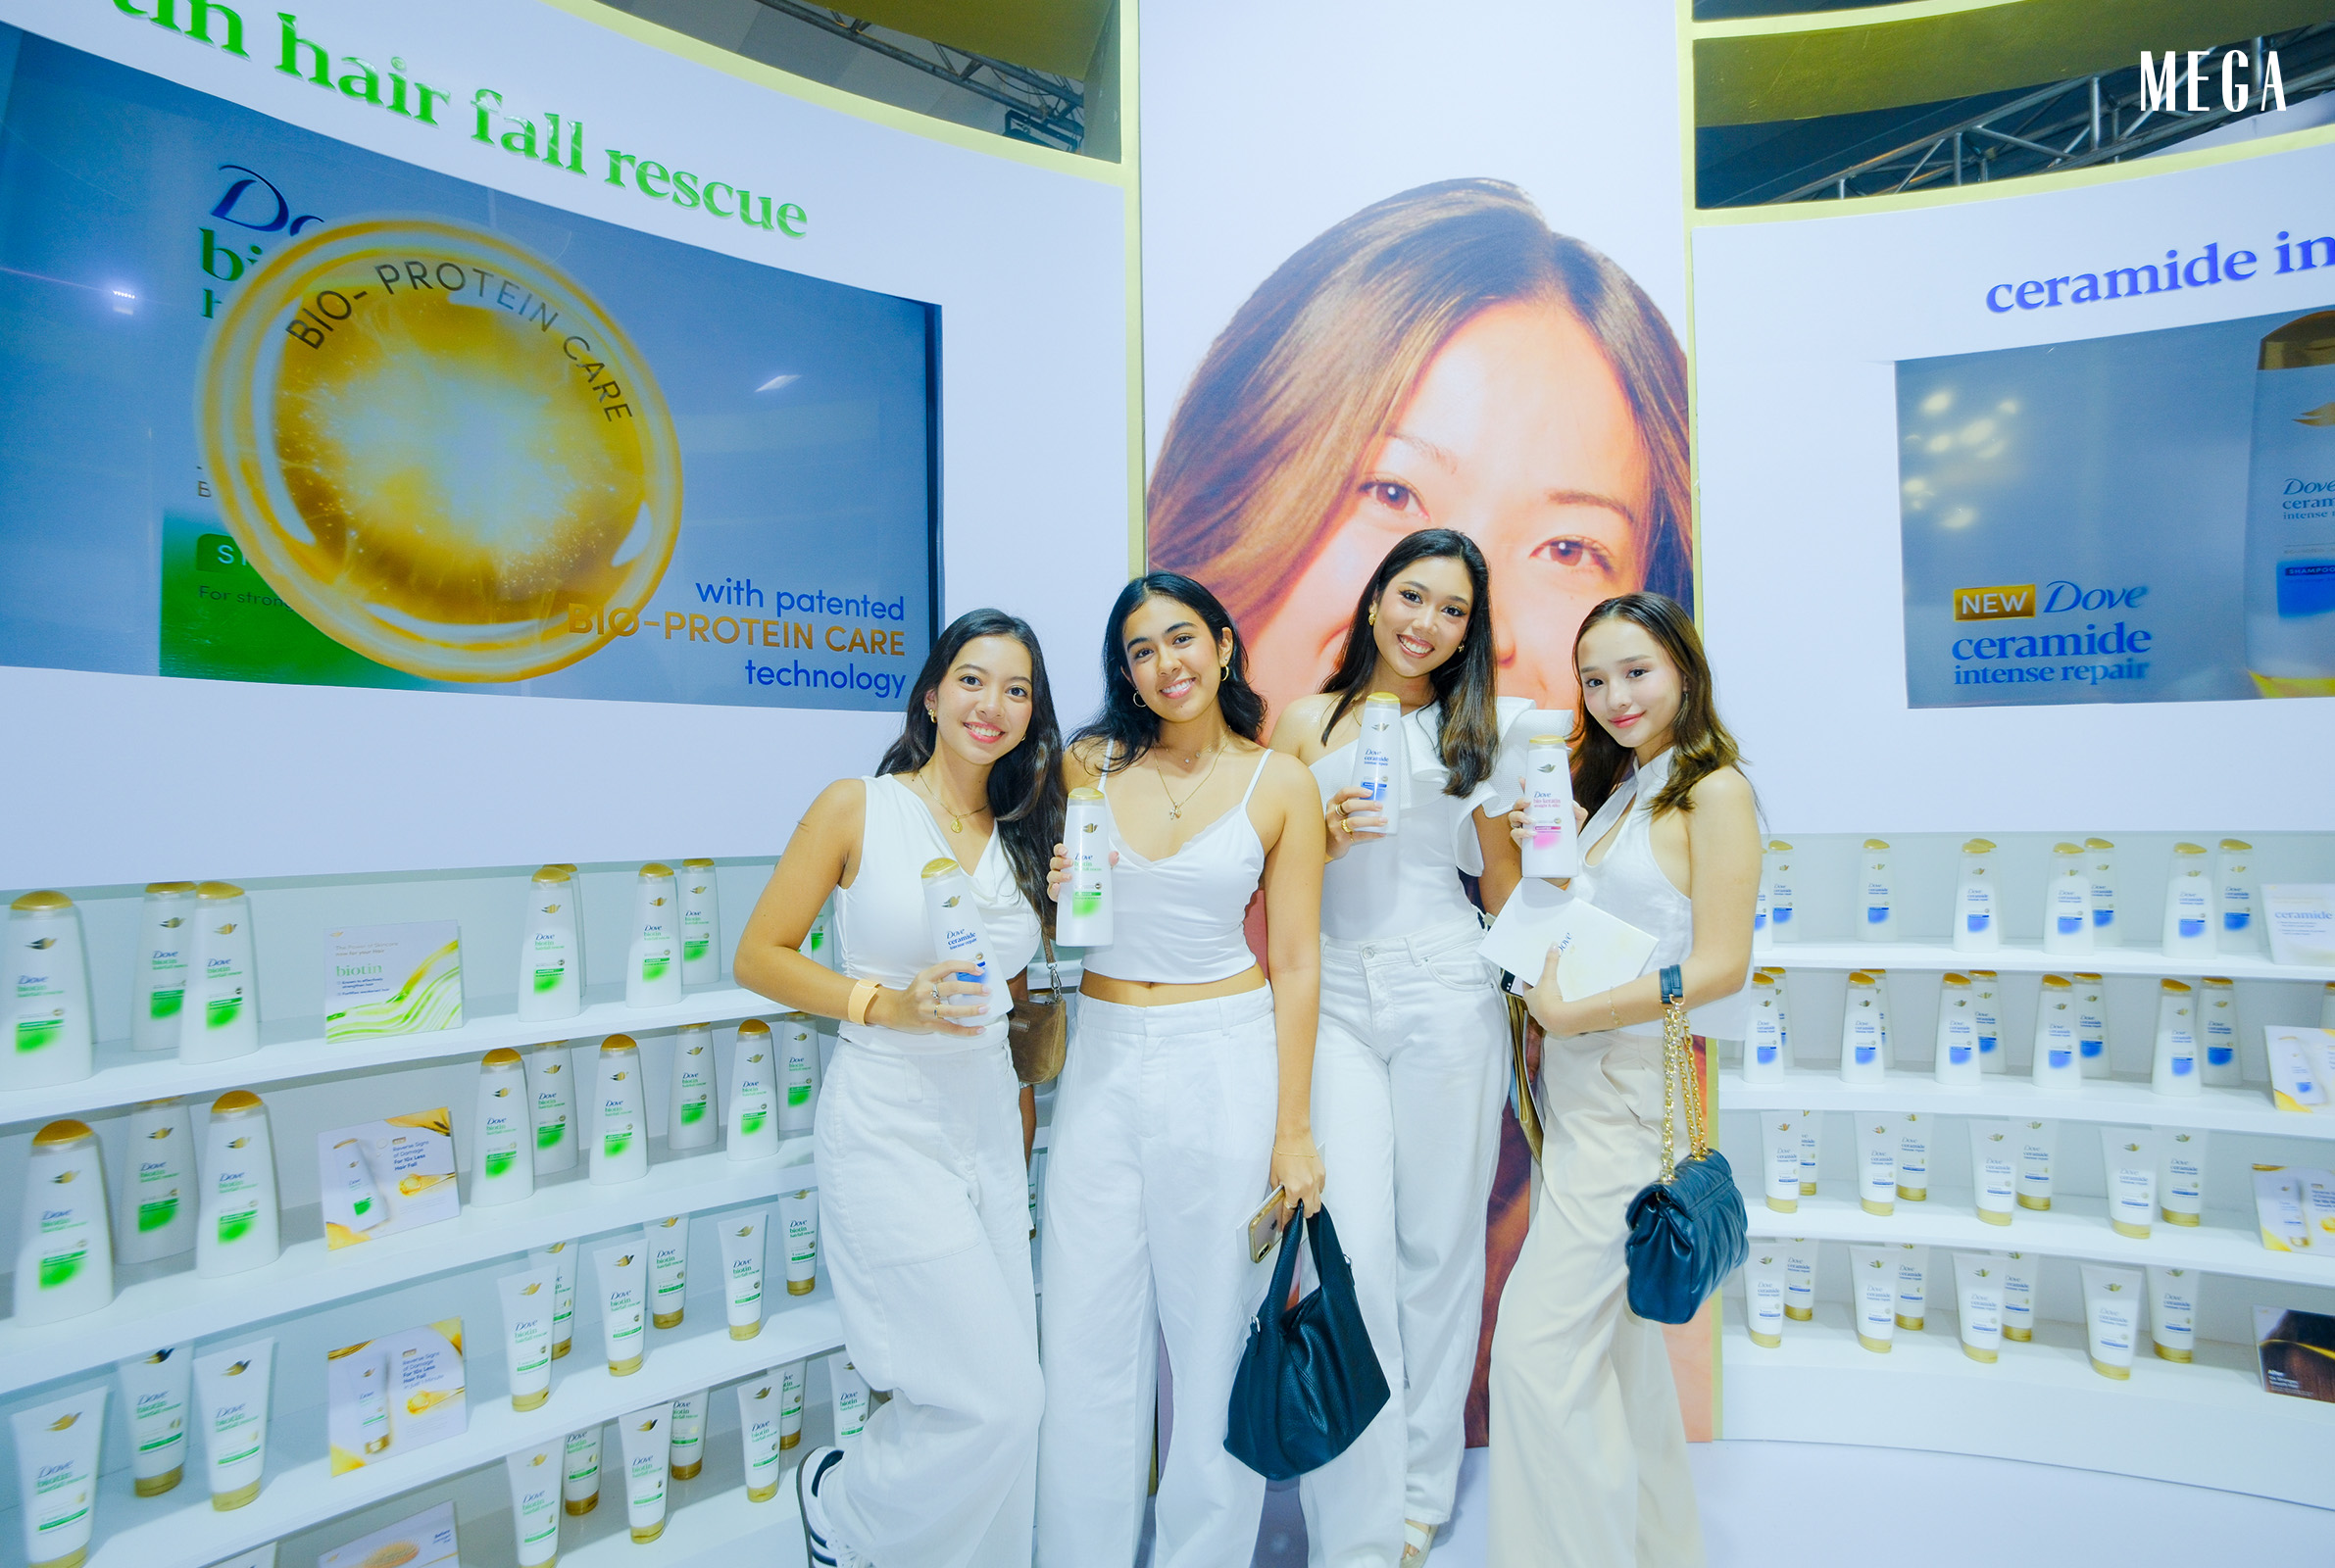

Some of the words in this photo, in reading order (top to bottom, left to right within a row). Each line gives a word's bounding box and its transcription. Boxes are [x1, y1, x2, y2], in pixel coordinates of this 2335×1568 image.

[274, 12, 450, 125] hair
[471, 88, 587, 176] fall
[604, 149, 808, 238] rescue
[1986, 241, 2257, 313] ceramide
[563, 335, 633, 423] CARE
[2283, 477, 2335, 495] Dove
[2283, 511, 2328, 519] intense
[198, 586, 231, 600] For
[695, 577, 764, 608] with
[776, 589, 905, 620] patented
[1962, 591, 2028, 615] NEW
[2043, 580, 2149, 613] Dove
[568, 603, 814, 651] BIO-PROTEIN
[824, 625, 906, 657] CARE
[1952, 620, 2153, 662] ceramide
[745, 660, 907, 699] technology
[1954, 664, 2055, 685] intense
[2061, 659, 2150, 686] repair
[946, 928, 965, 940] Dove
[336, 963, 382, 976] biotin
